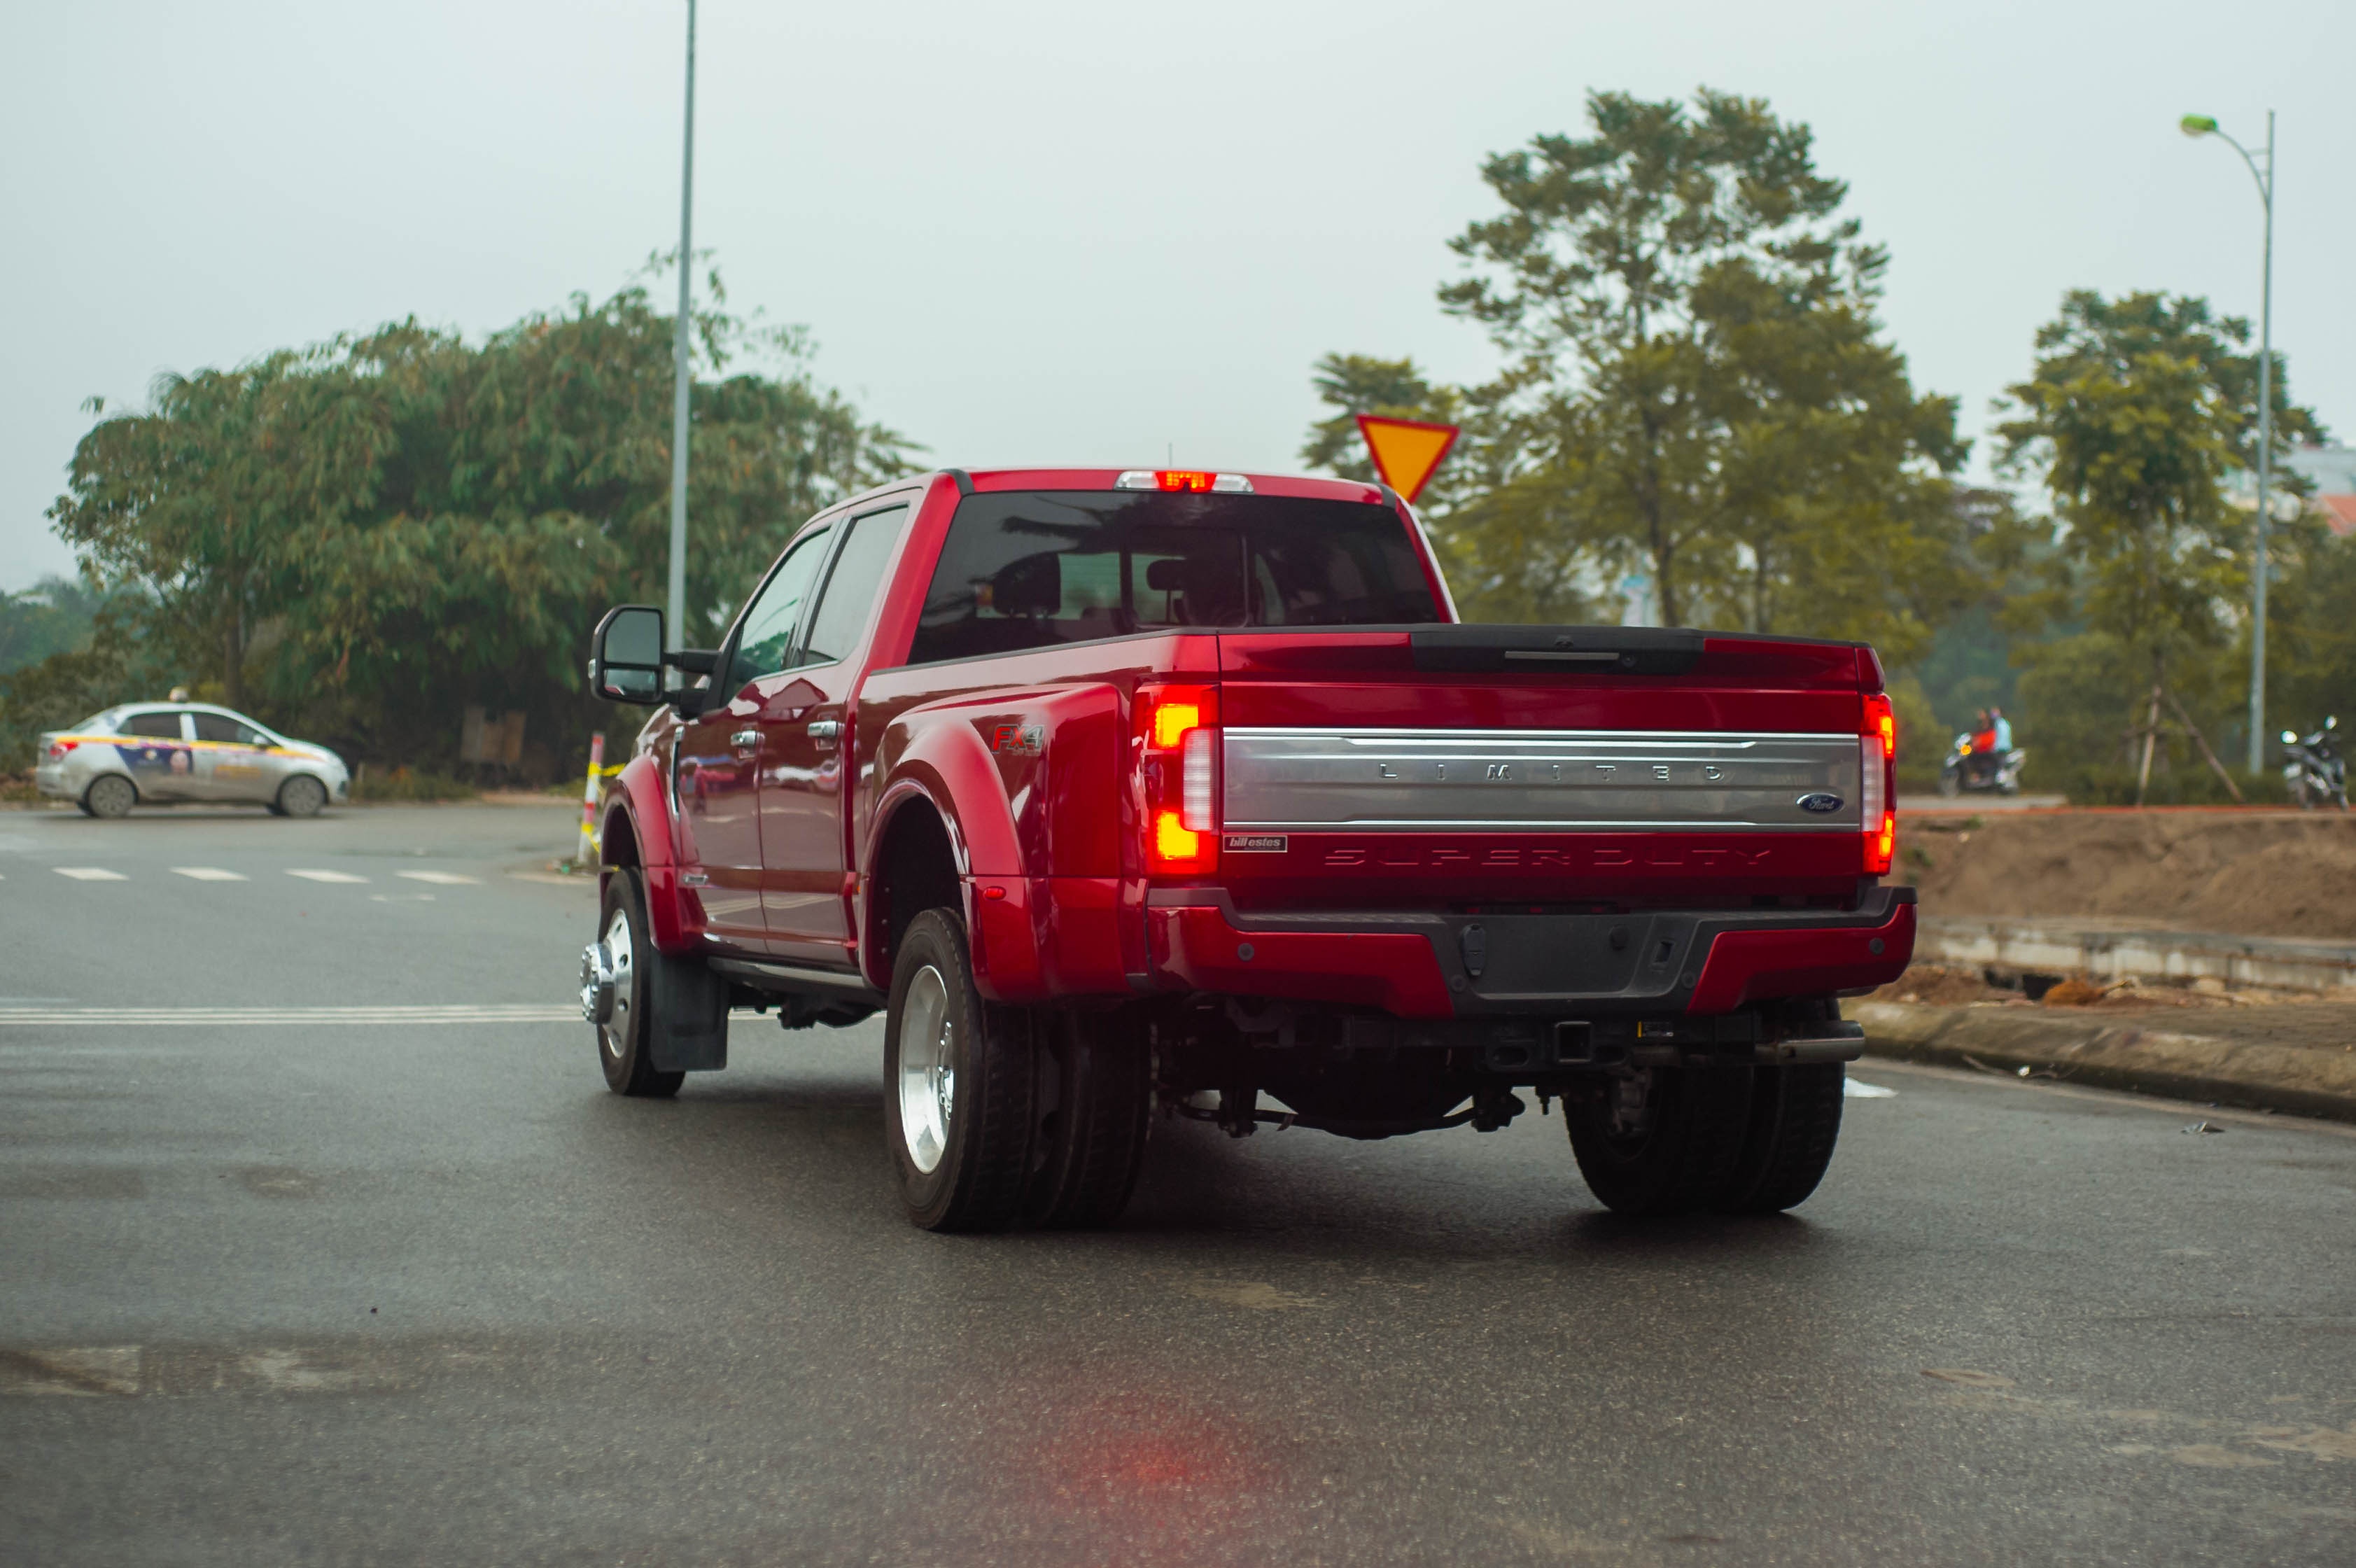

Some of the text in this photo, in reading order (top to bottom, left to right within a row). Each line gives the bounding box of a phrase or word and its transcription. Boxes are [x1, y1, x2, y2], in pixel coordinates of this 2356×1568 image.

[992, 724, 1045, 754] FX4
[1379, 763, 1725, 781] LIMITED
[1808, 797, 1835, 810] Ford
[1230, 837, 1281, 847] bill estes
[1324, 848, 1771, 866] SUPER DUTY
